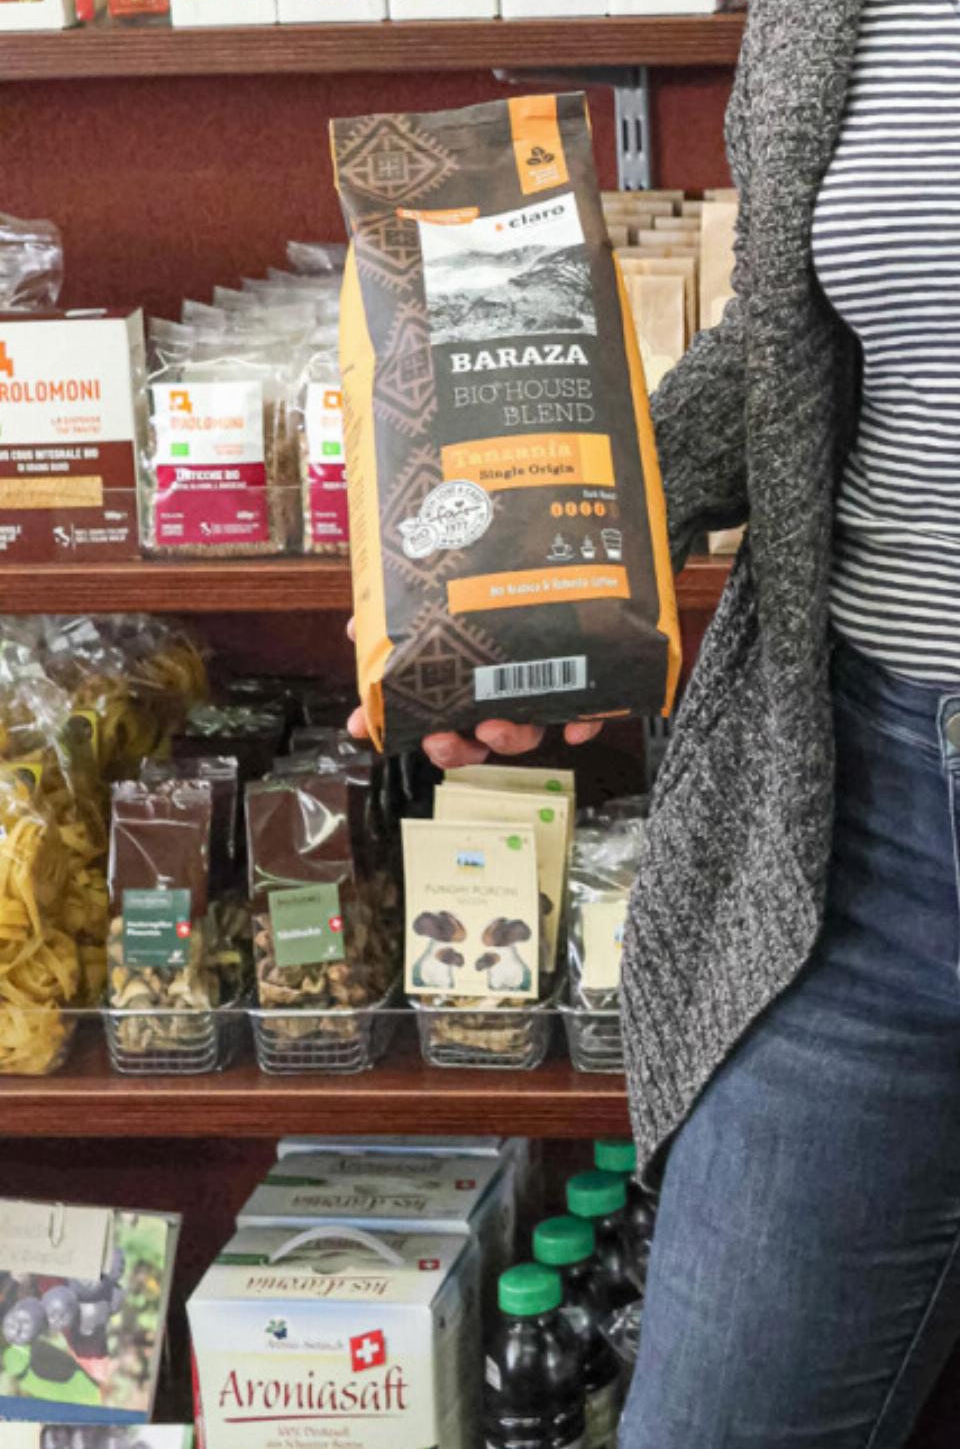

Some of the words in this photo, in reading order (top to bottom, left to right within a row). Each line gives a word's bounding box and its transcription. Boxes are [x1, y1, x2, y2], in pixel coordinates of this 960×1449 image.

[508, 204, 565, 229] claro
[450, 344, 589, 373] BARAZA
[454, 384, 498, 408] BIO
[503, 377, 594, 402] HOUSE
[503, 402, 596, 427] BLEND
[451, 439, 573, 468] Tanzania
[479, 465, 526, 480] Single
[528, 462, 575, 476] Origin
[219, 1365, 409, 1411] Aroniasaft
